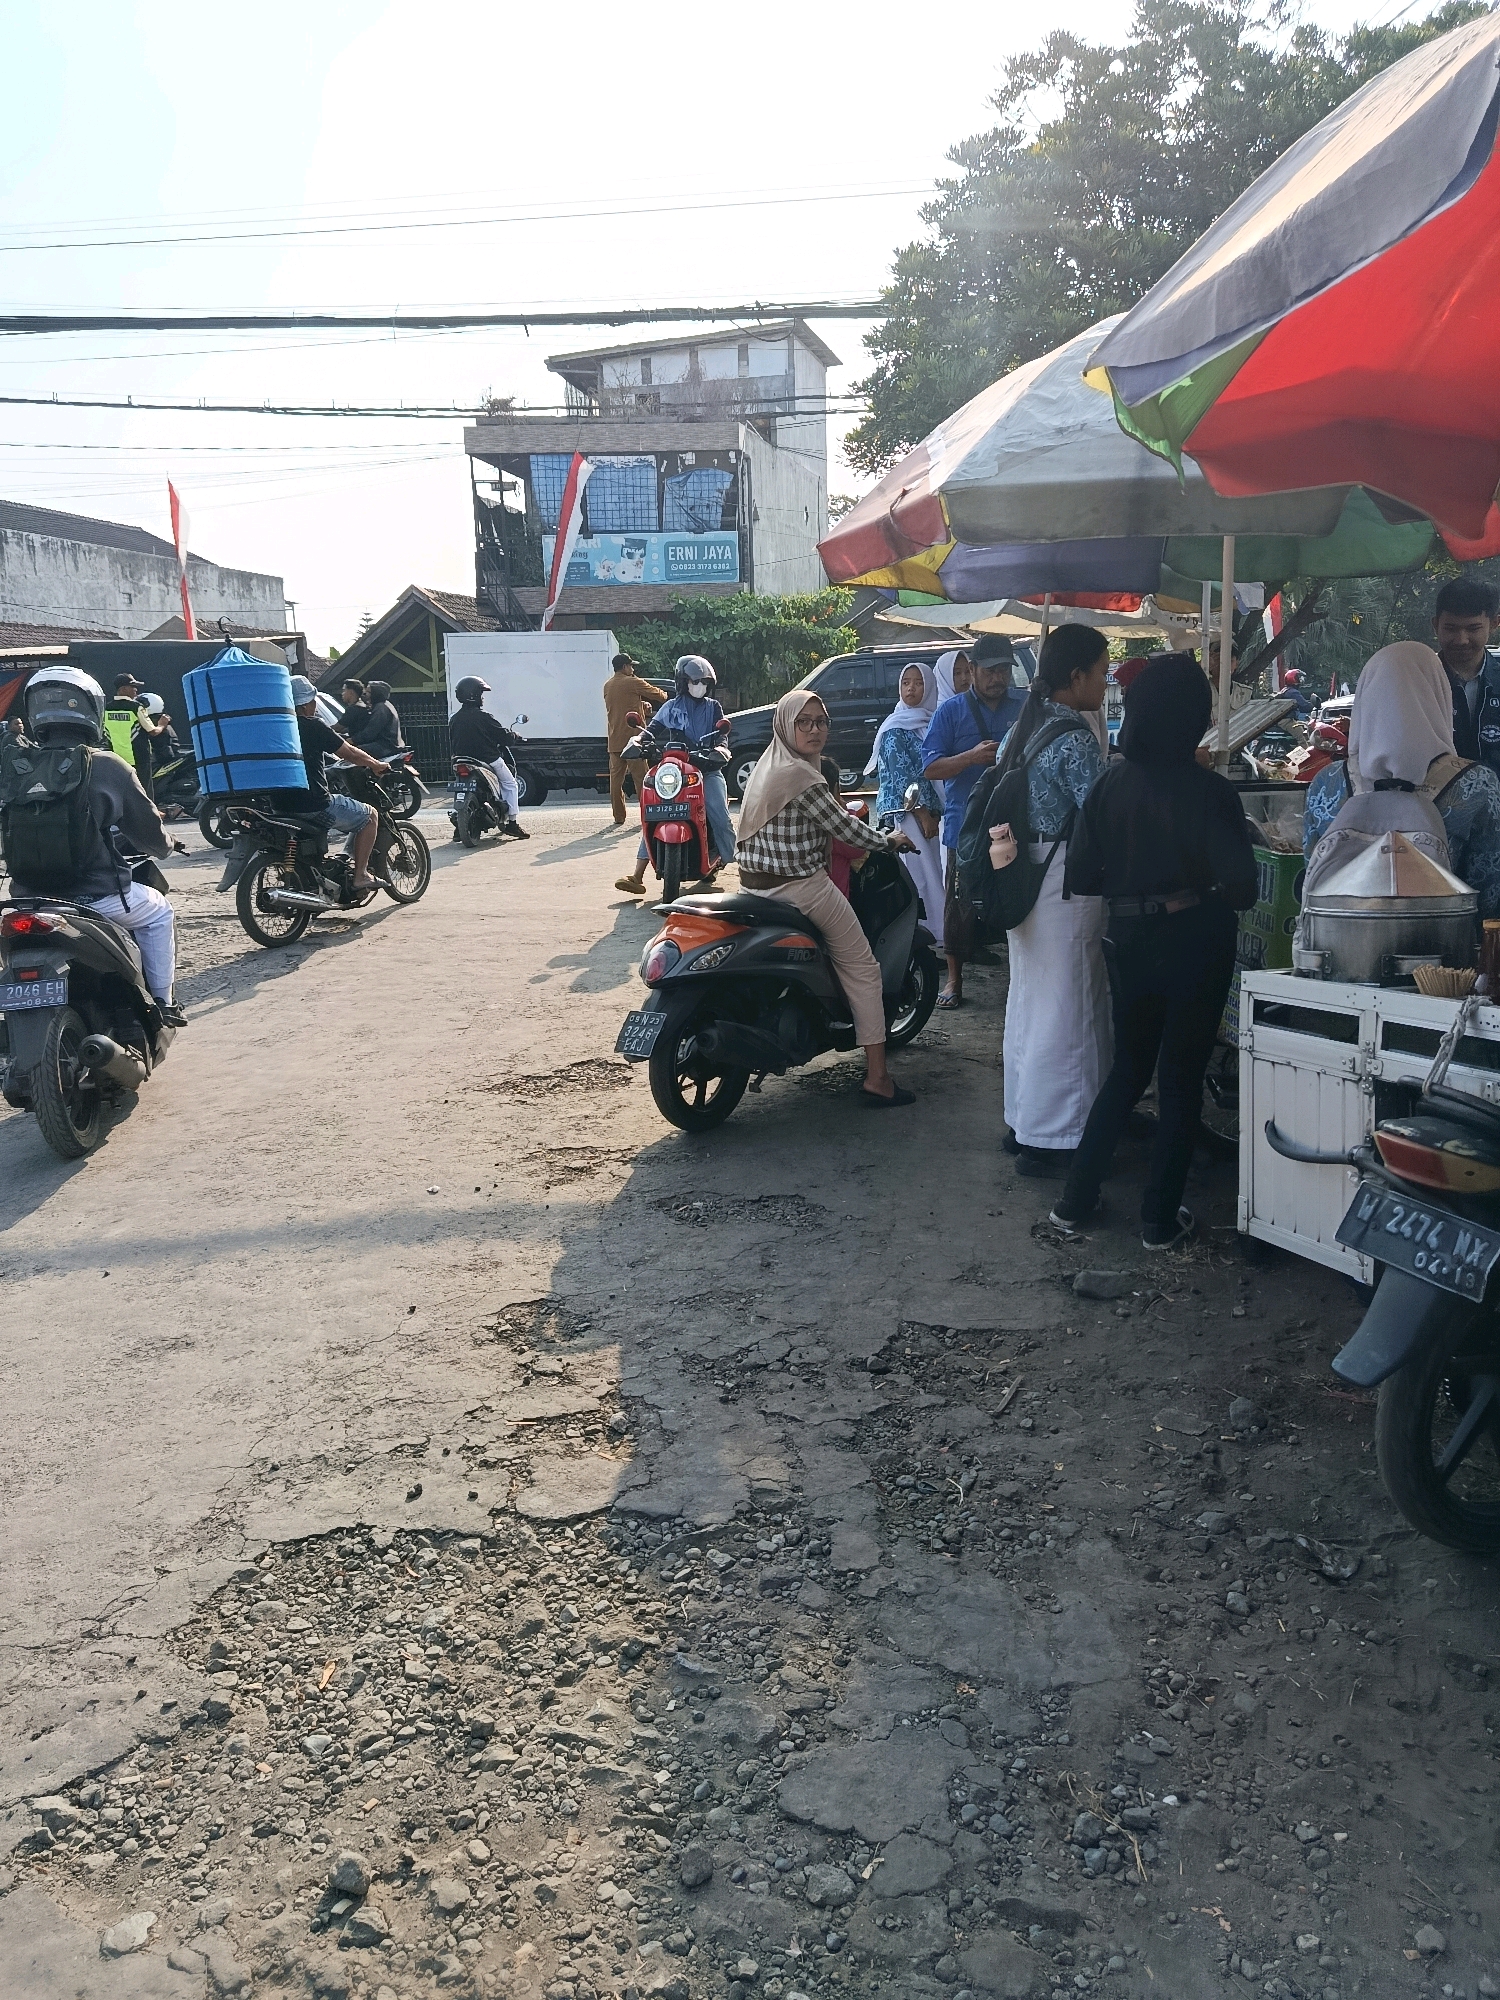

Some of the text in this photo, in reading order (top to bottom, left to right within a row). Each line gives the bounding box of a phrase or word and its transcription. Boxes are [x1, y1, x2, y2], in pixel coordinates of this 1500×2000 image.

[668, 545, 733, 561] ERNI JAYA
[656, 805, 673, 813] 3126
[6, 981, 64, 999] 2046 EH
[624, 1025, 654, 1041] 3246
[623, 1037, 646, 1052] EAJ
